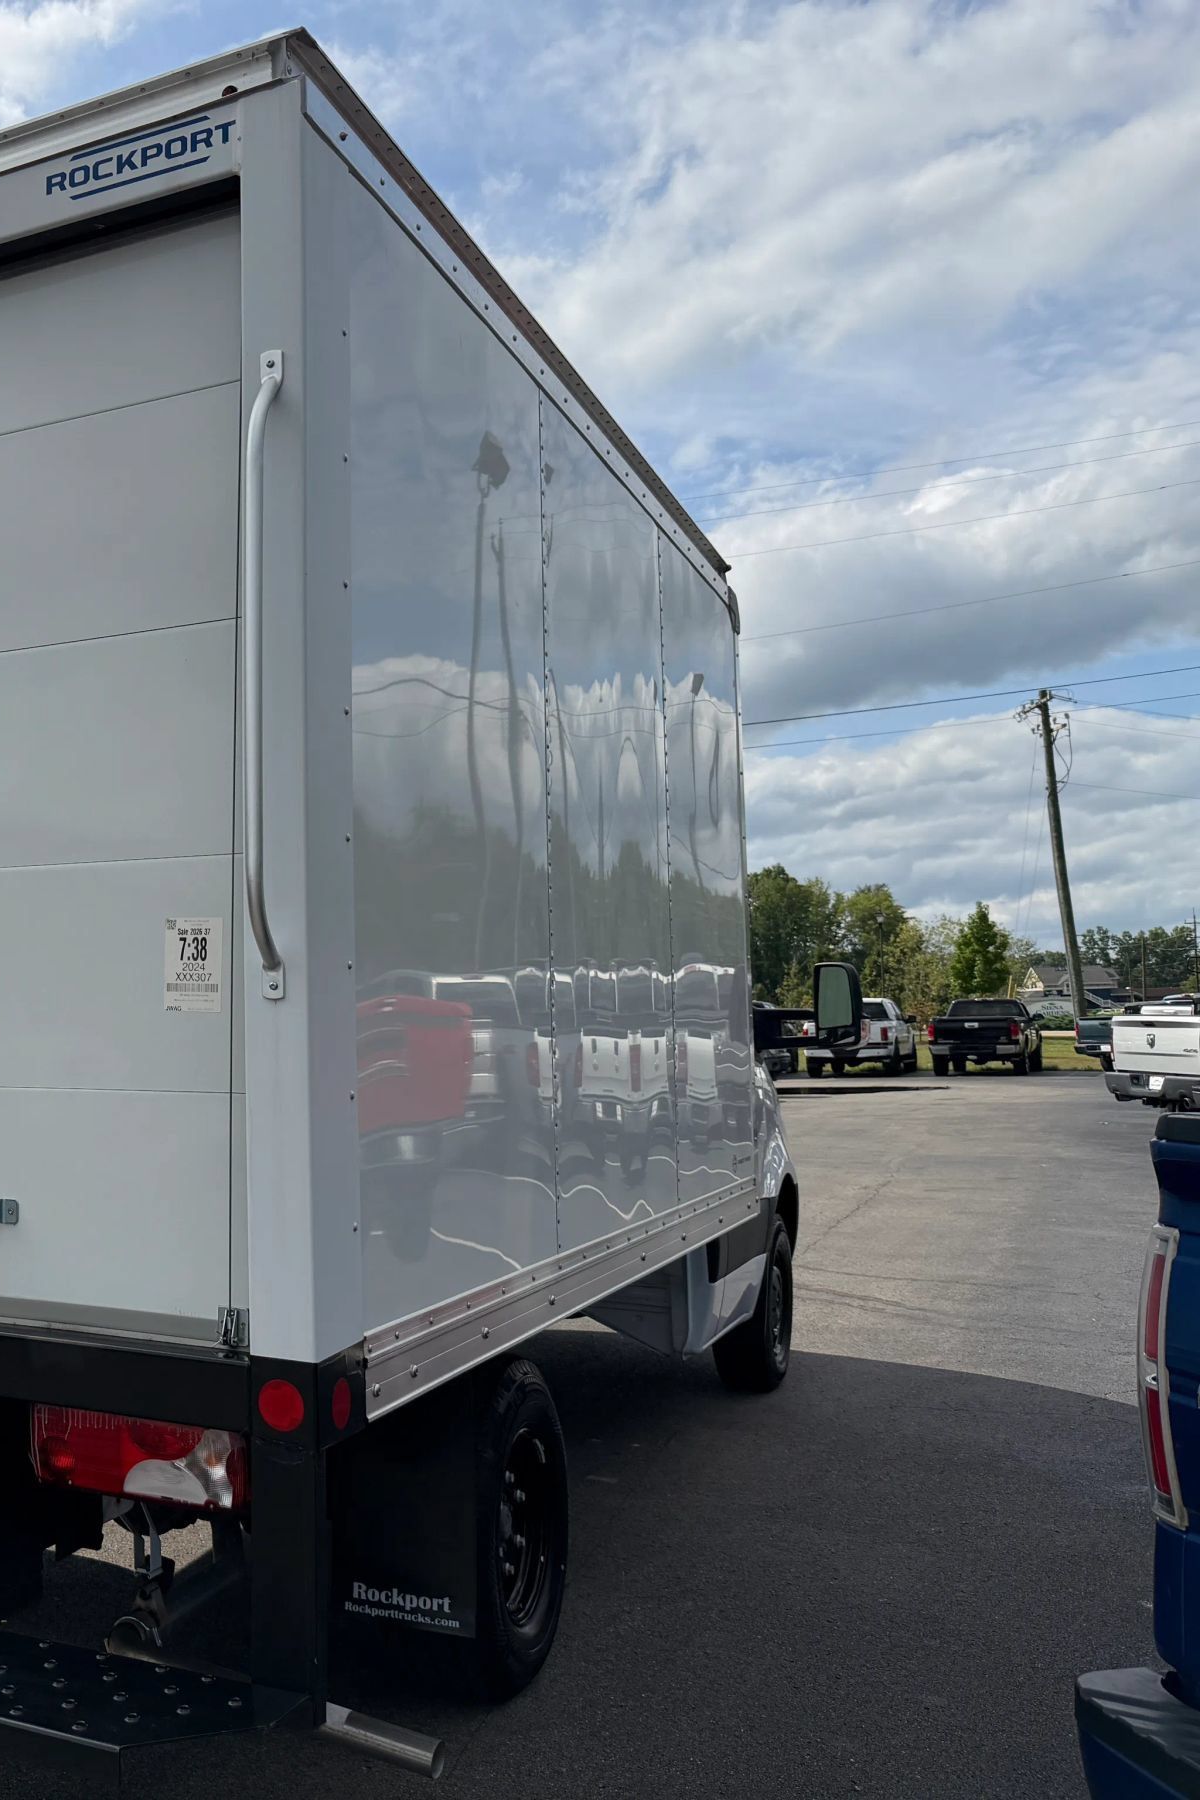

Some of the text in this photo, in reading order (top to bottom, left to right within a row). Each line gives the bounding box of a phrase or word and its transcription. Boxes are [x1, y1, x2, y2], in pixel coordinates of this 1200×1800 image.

[46, 120, 236, 195] ROCKPORT
[177, 928, 188, 936] Sale
[179, 937, 207, 961] 7:38
[175, 972, 212, 982] XXX307
[182, 962, 205, 972] 2024
[352, 1581, 451, 1613] Rockport
[344, 1601, 460, 1628] Rockporttrucks.com
